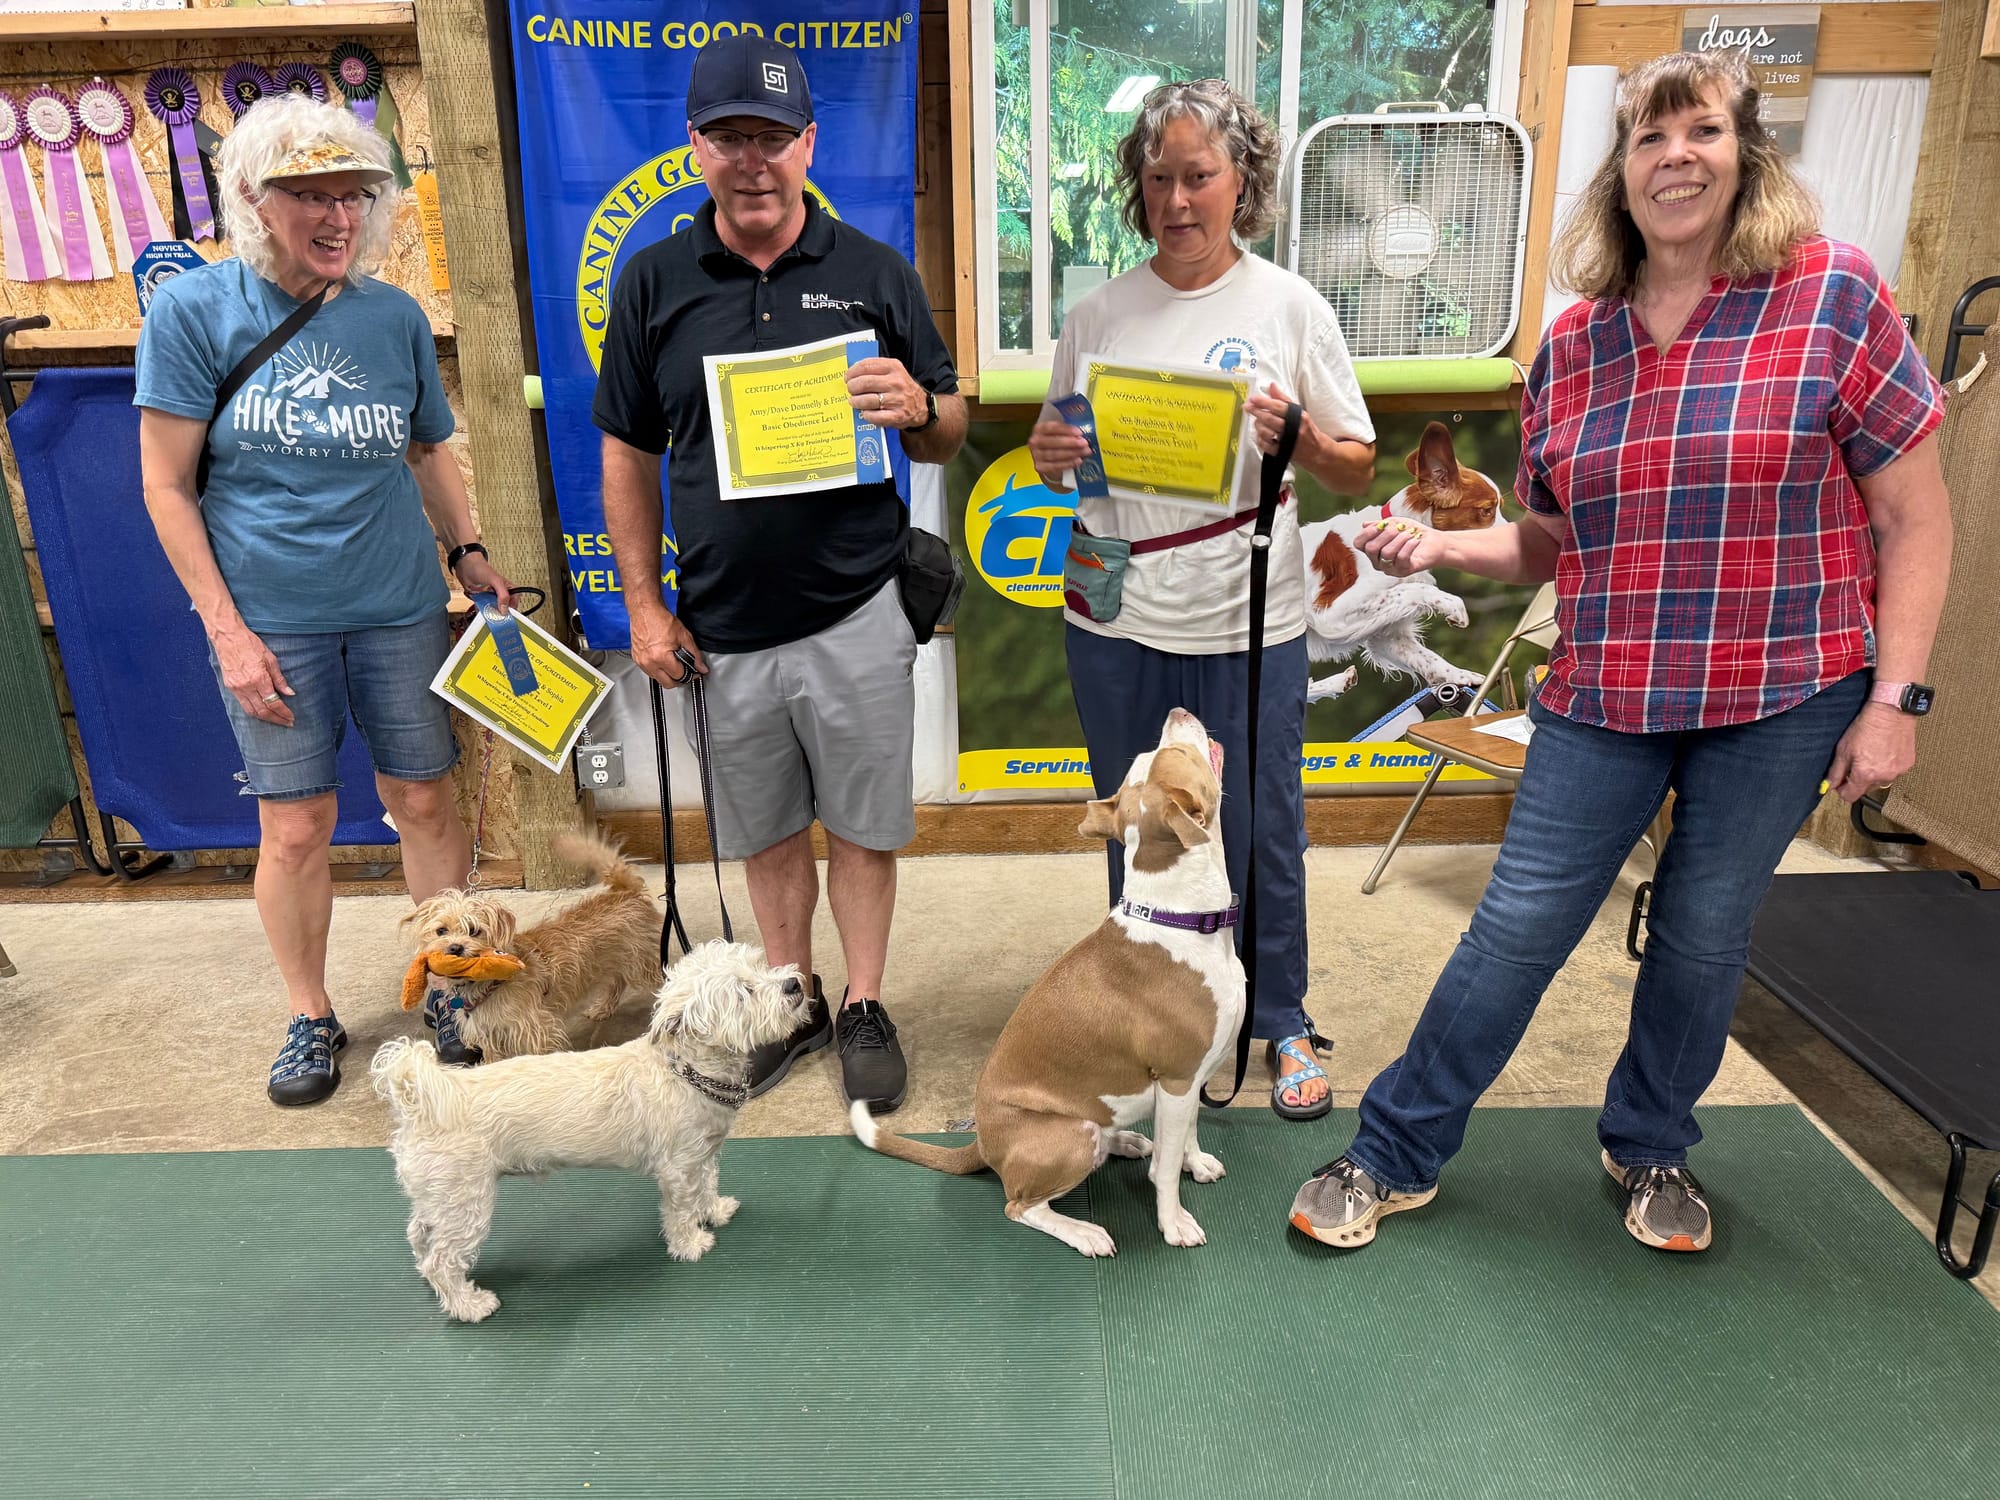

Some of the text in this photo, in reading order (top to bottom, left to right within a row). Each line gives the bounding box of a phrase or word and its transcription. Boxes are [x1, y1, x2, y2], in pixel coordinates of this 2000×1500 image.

[527, 15, 652, 49] CANINE
[1698, 14, 1776, 61] dogs
[1752, 51, 1802, 63] are not
[1764, 72, 1800, 84] lives
[152, 244, 184, 252] NOVICE
[583, 179, 651, 331] CANINE
[801, 301, 850, 311] SUPPLY
[744, 382, 792, 394] CERTIFICATE
[750, 406, 790, 417] Amy/Dave
[823, 397, 830, 406] &
[233, 384, 405, 449] HIKE MORE
[783, 418, 820, 428] Obedience
[821, 413, 839, 423] Level
[261, 444, 380, 460] WORRY LESS
[1344, 753, 1362, 768] &
